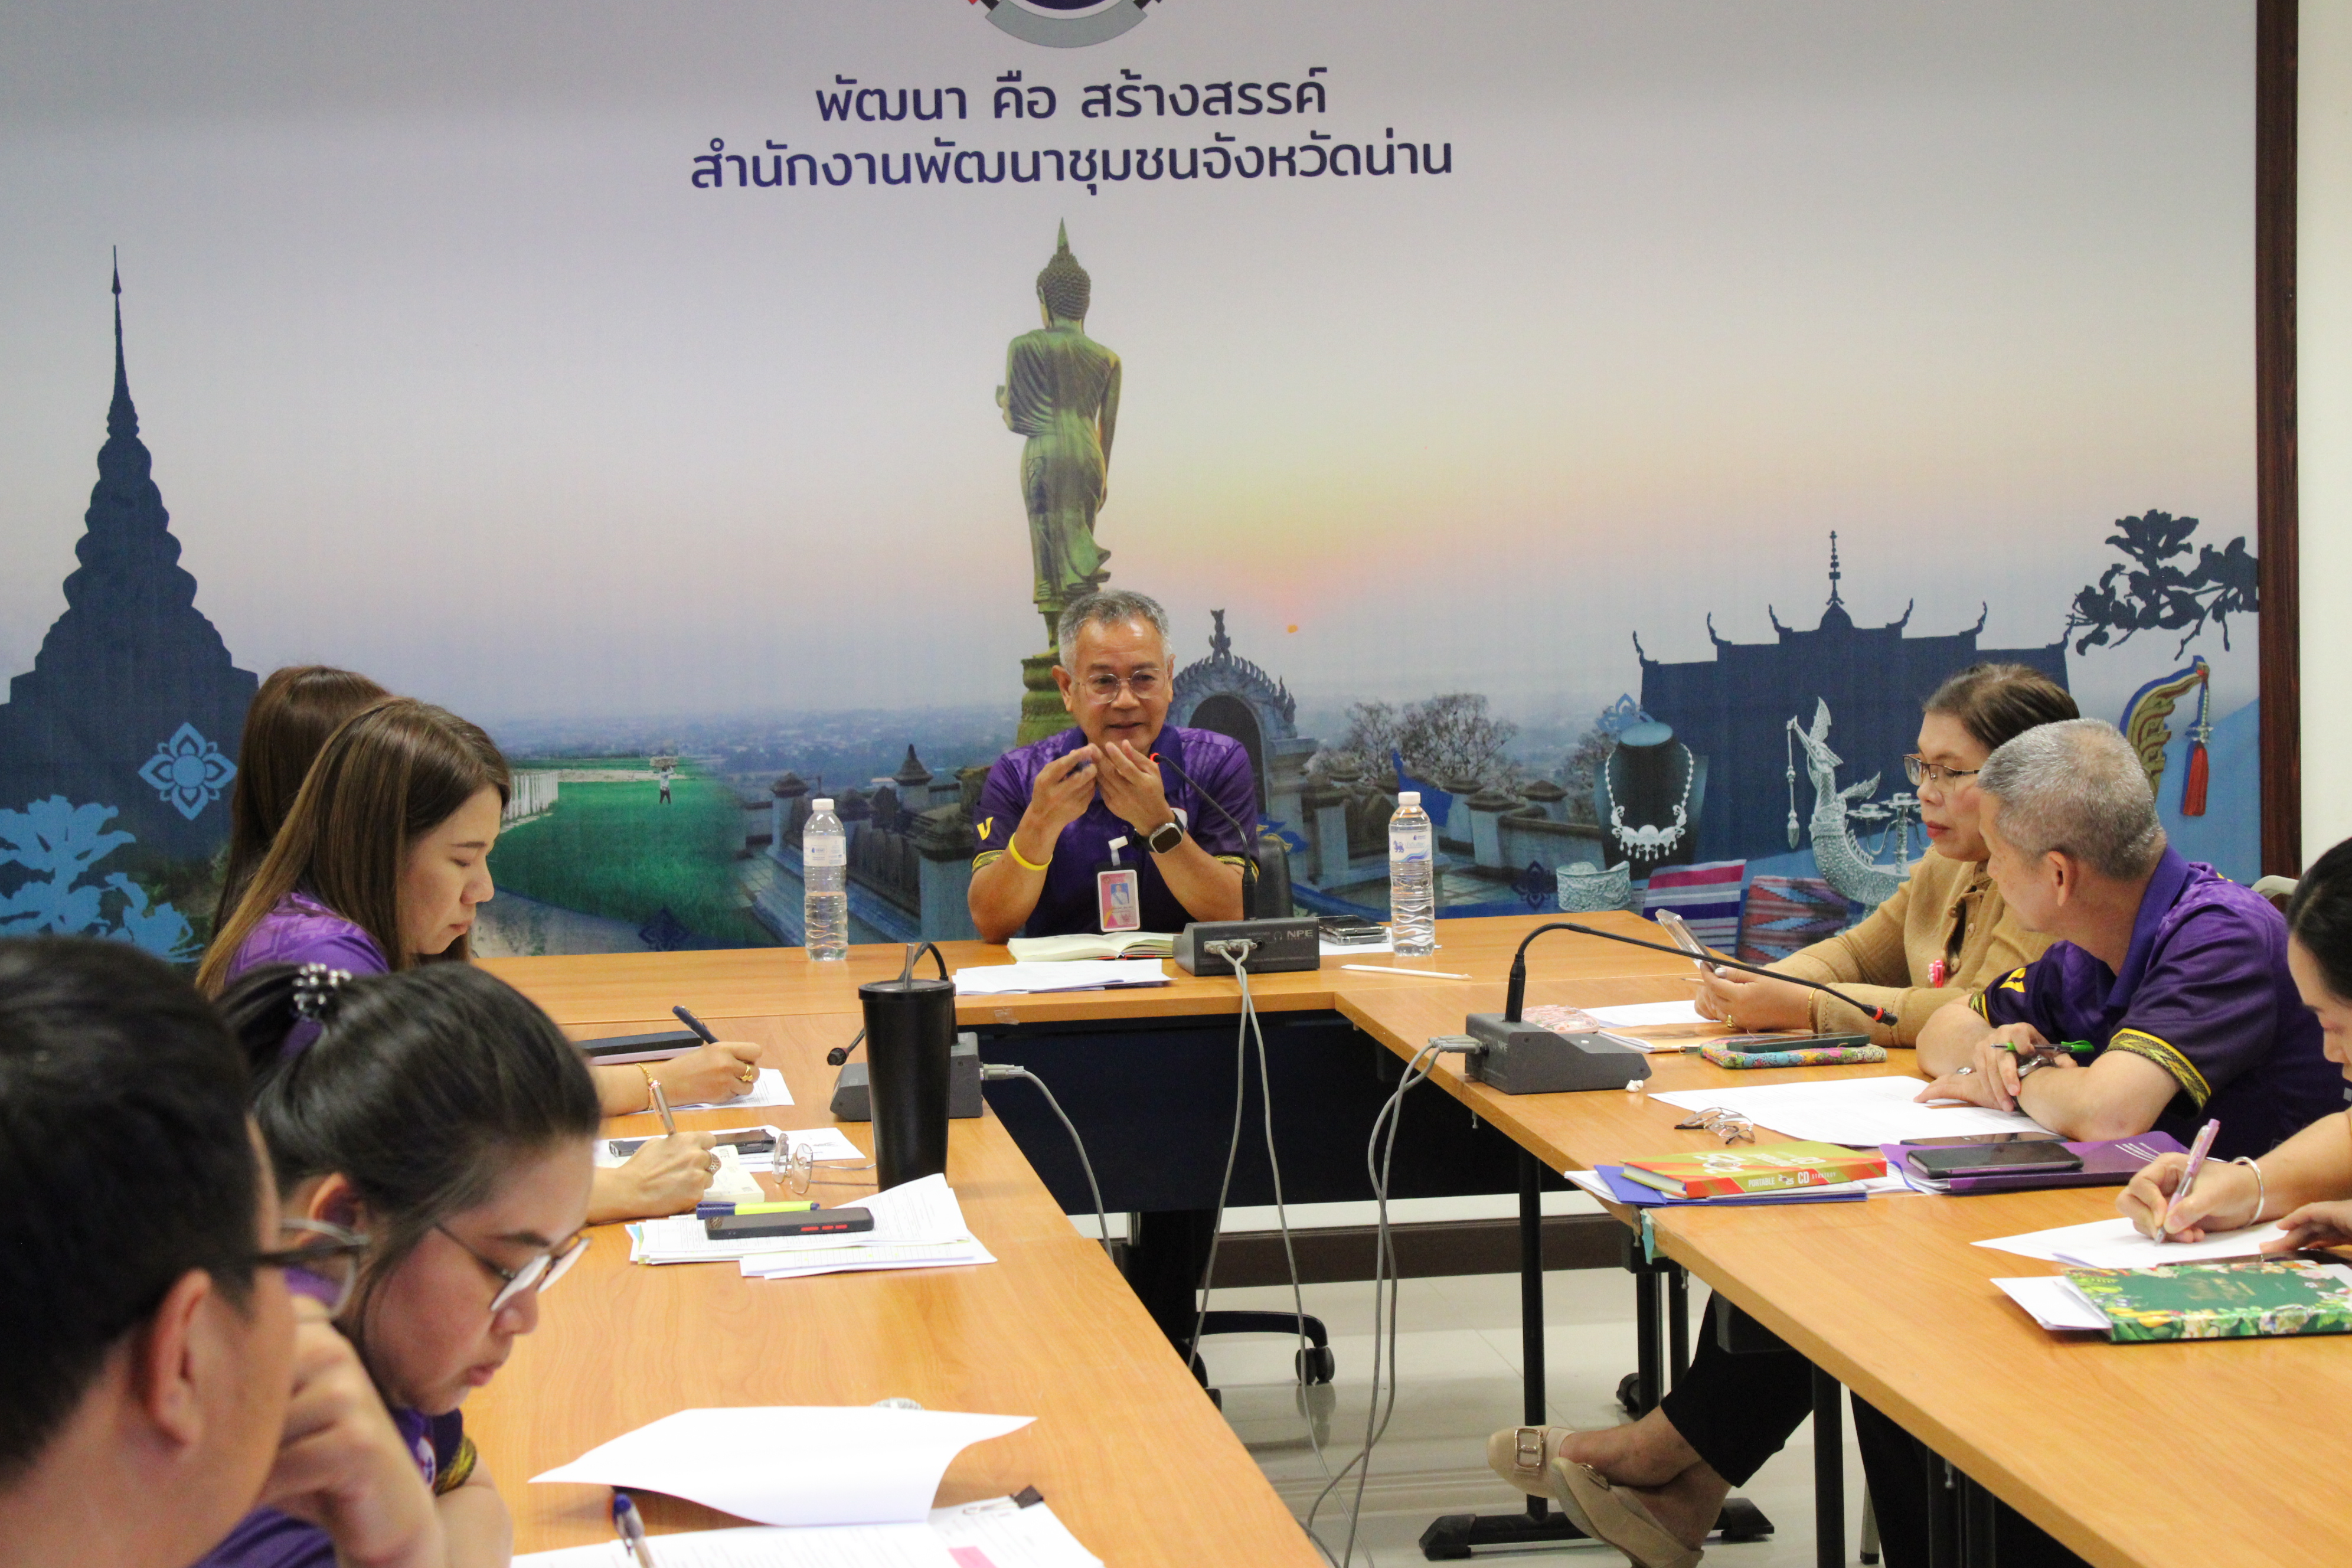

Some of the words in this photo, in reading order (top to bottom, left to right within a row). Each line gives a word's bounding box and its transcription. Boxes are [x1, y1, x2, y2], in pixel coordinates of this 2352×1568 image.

[815, 74, 968, 122] พัฒนา
[994, 69, 1057, 119] คือ
[1081, 67, 1328, 118] สร้างสรรค์
[691, 127, 1452, 196] สำนักงานพัฒนาชุมชนจังหวัดน่าน
[1287, 929, 1313, 937] NPE
[1749, 1177, 1775, 1187] PORTABLE
[1798, 1171, 1810, 1184] CD
